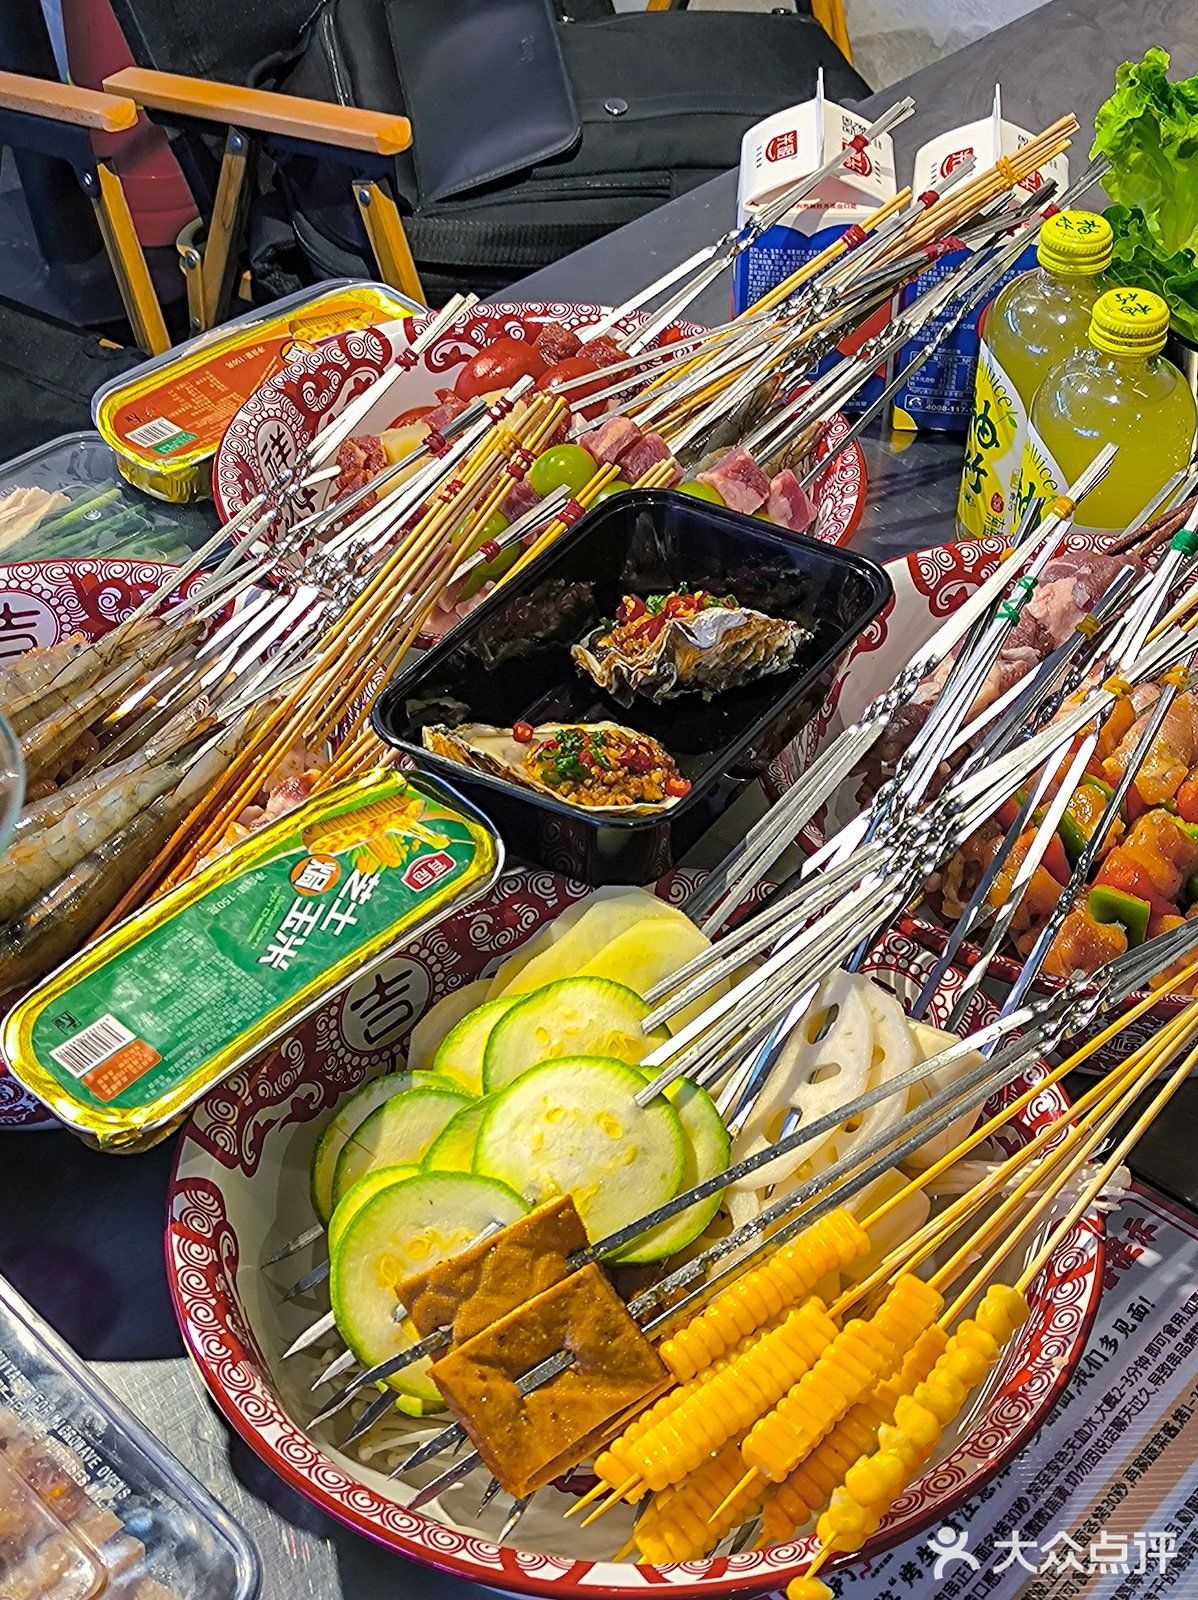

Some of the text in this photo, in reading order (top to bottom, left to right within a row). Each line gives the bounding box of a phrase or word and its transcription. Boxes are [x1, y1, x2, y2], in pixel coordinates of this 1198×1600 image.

[259, 897, 325, 971] 玉米
[320, 868, 381, 937] 芝士
[350, 969, 413, 1045] 吉
